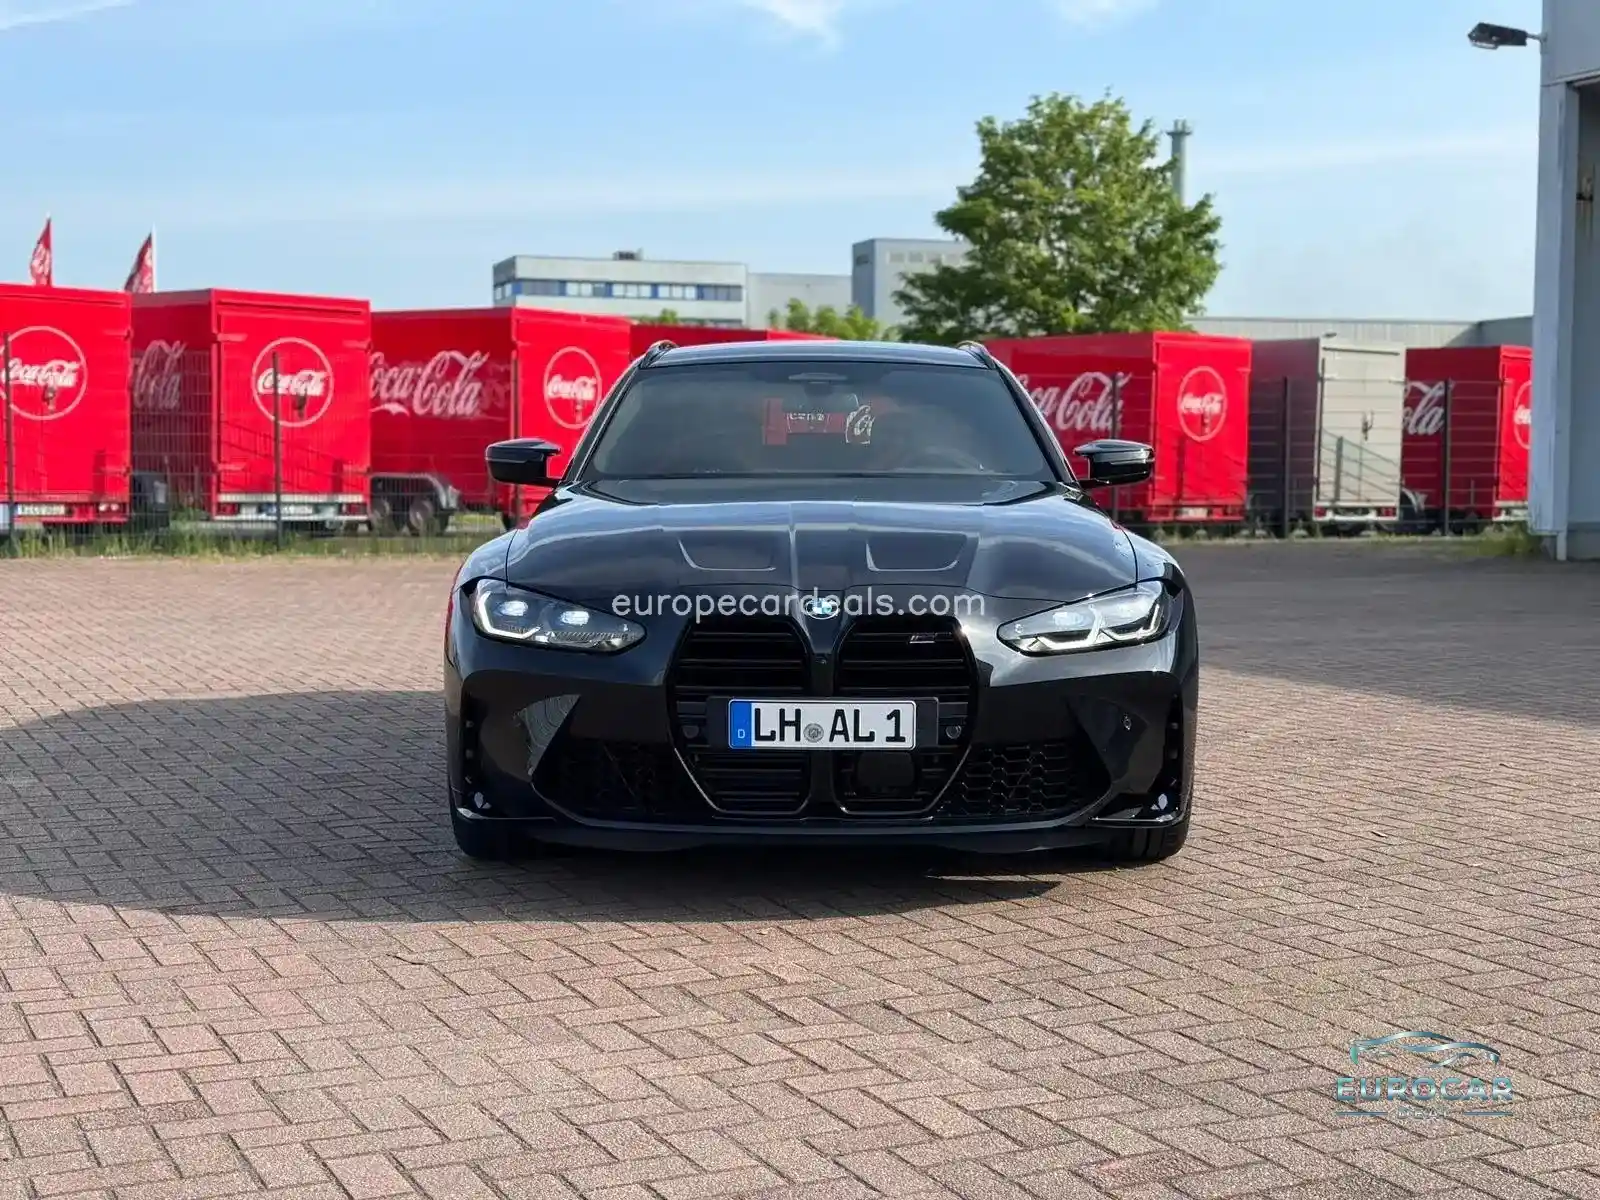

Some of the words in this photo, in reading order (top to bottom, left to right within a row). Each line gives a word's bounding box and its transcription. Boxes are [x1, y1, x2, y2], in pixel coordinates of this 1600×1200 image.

[737, 729, 746, 739] D
[754, 708, 802, 742] LH
[829, 708, 875, 743] AL
[885, 709, 906, 743] 1
